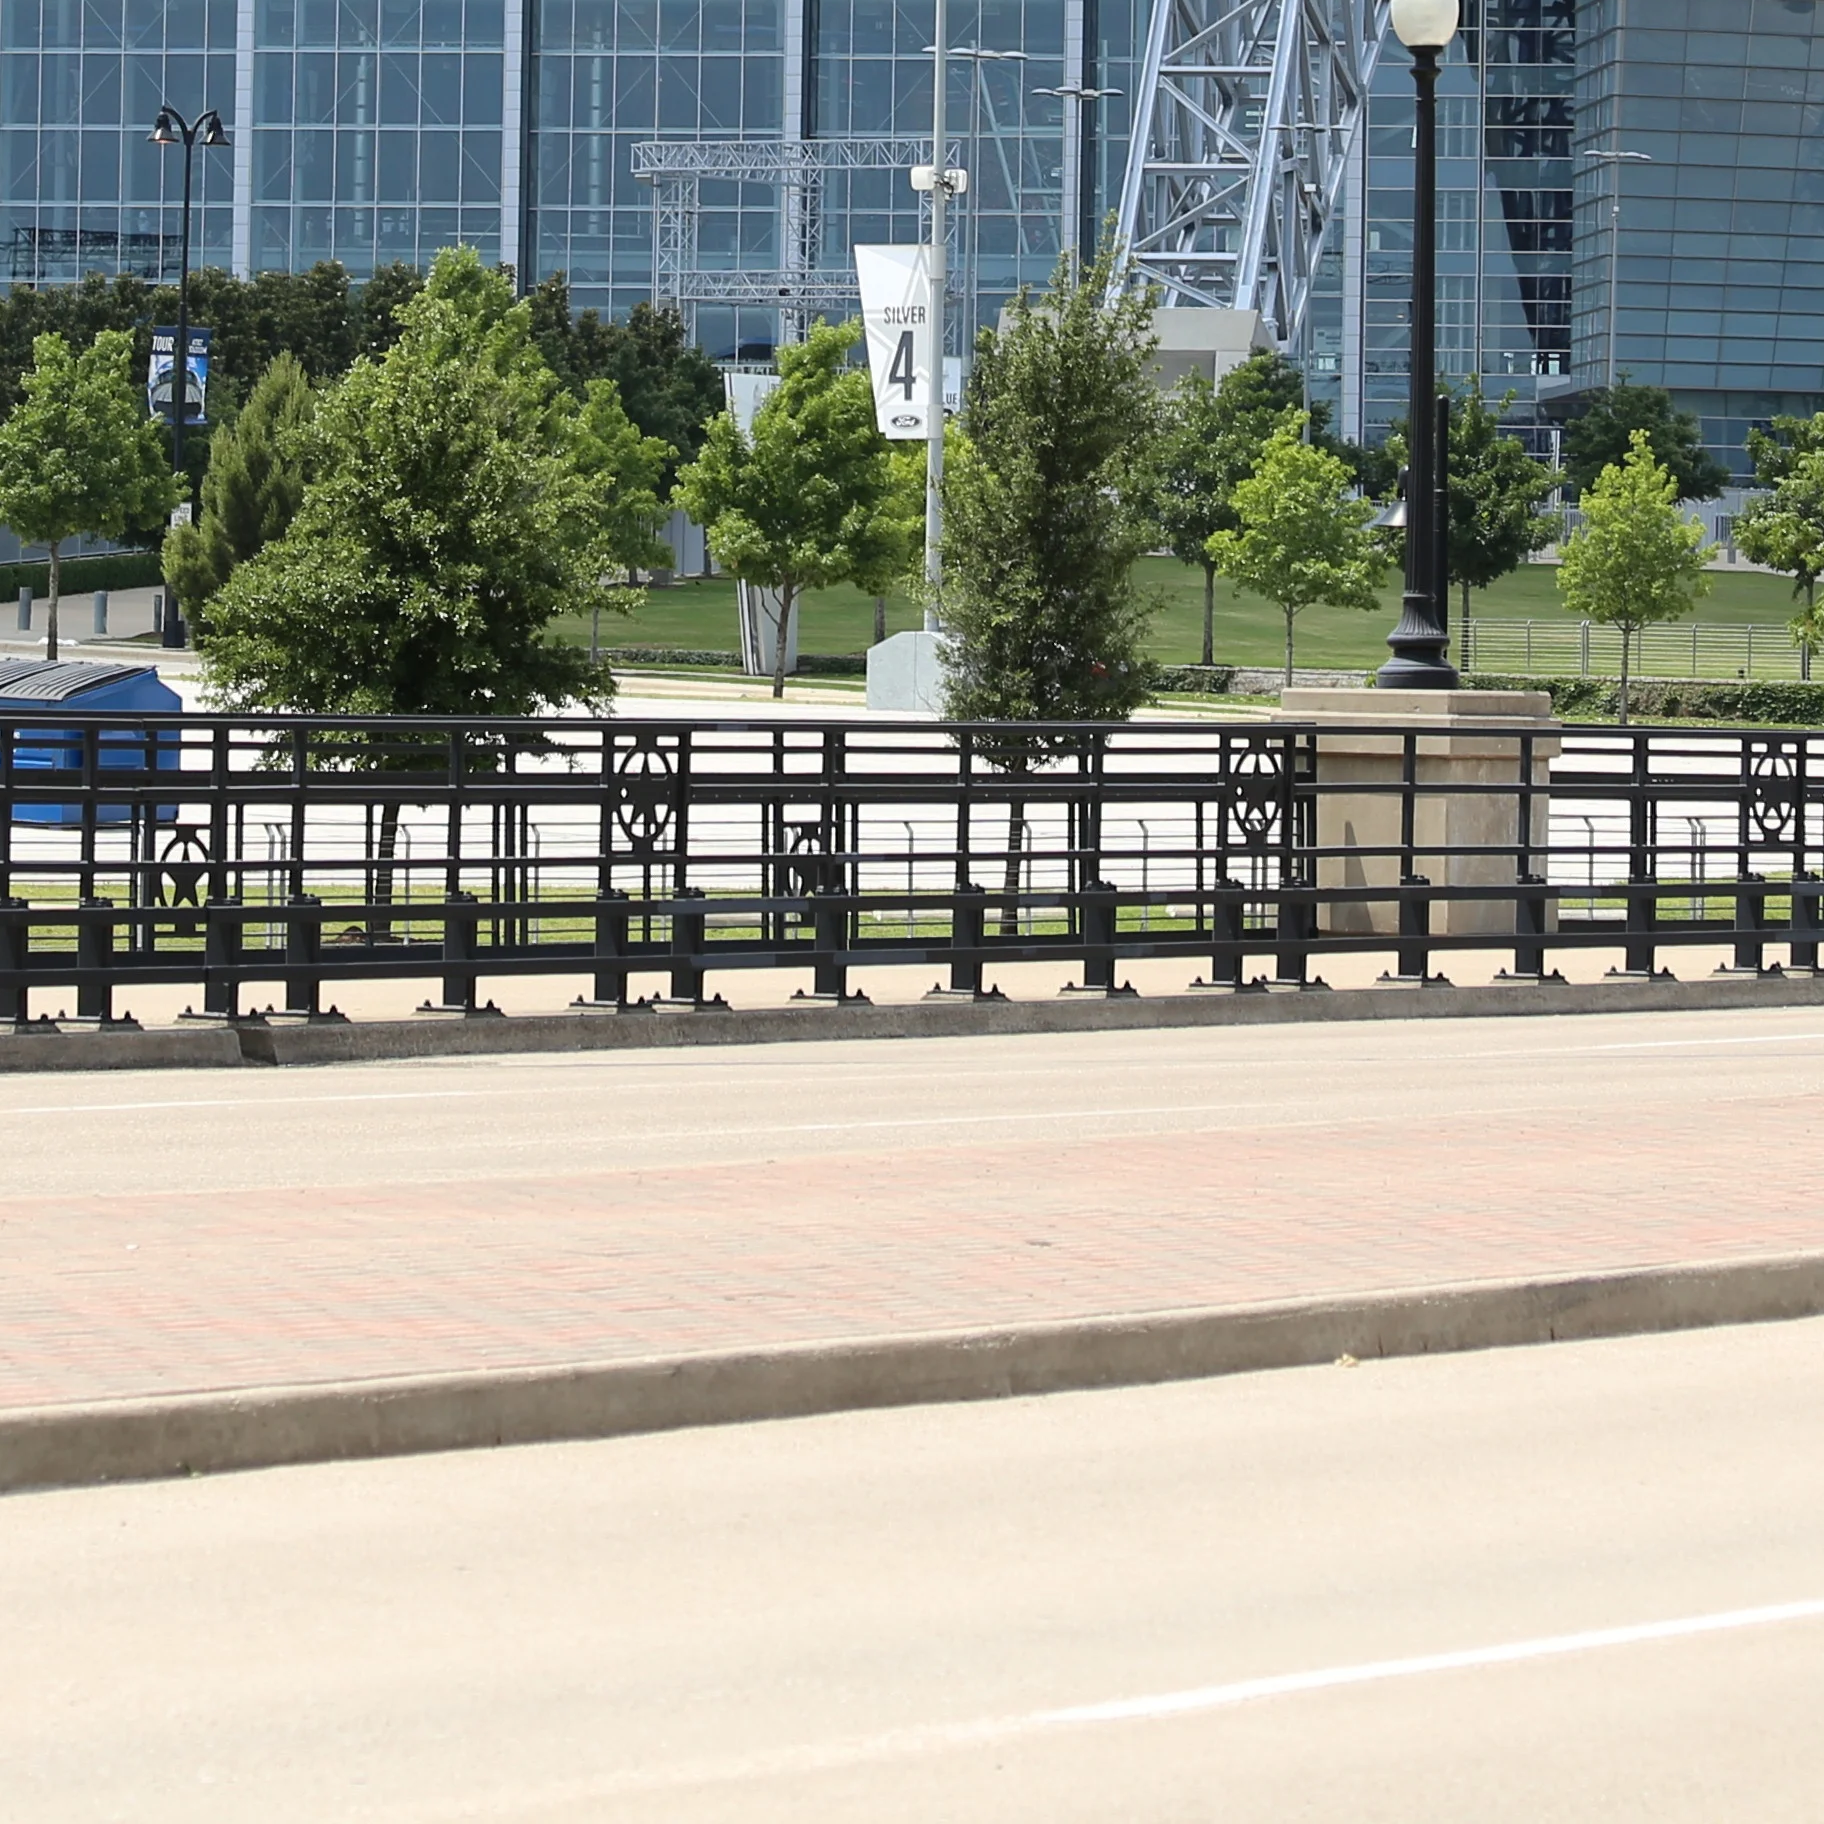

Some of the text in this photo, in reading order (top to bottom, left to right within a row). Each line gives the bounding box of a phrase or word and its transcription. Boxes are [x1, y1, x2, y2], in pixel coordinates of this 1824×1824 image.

[884, 306, 926, 324] SILVER
[152, 336, 175, 352] TOUR
[889, 330, 916, 401] 4
